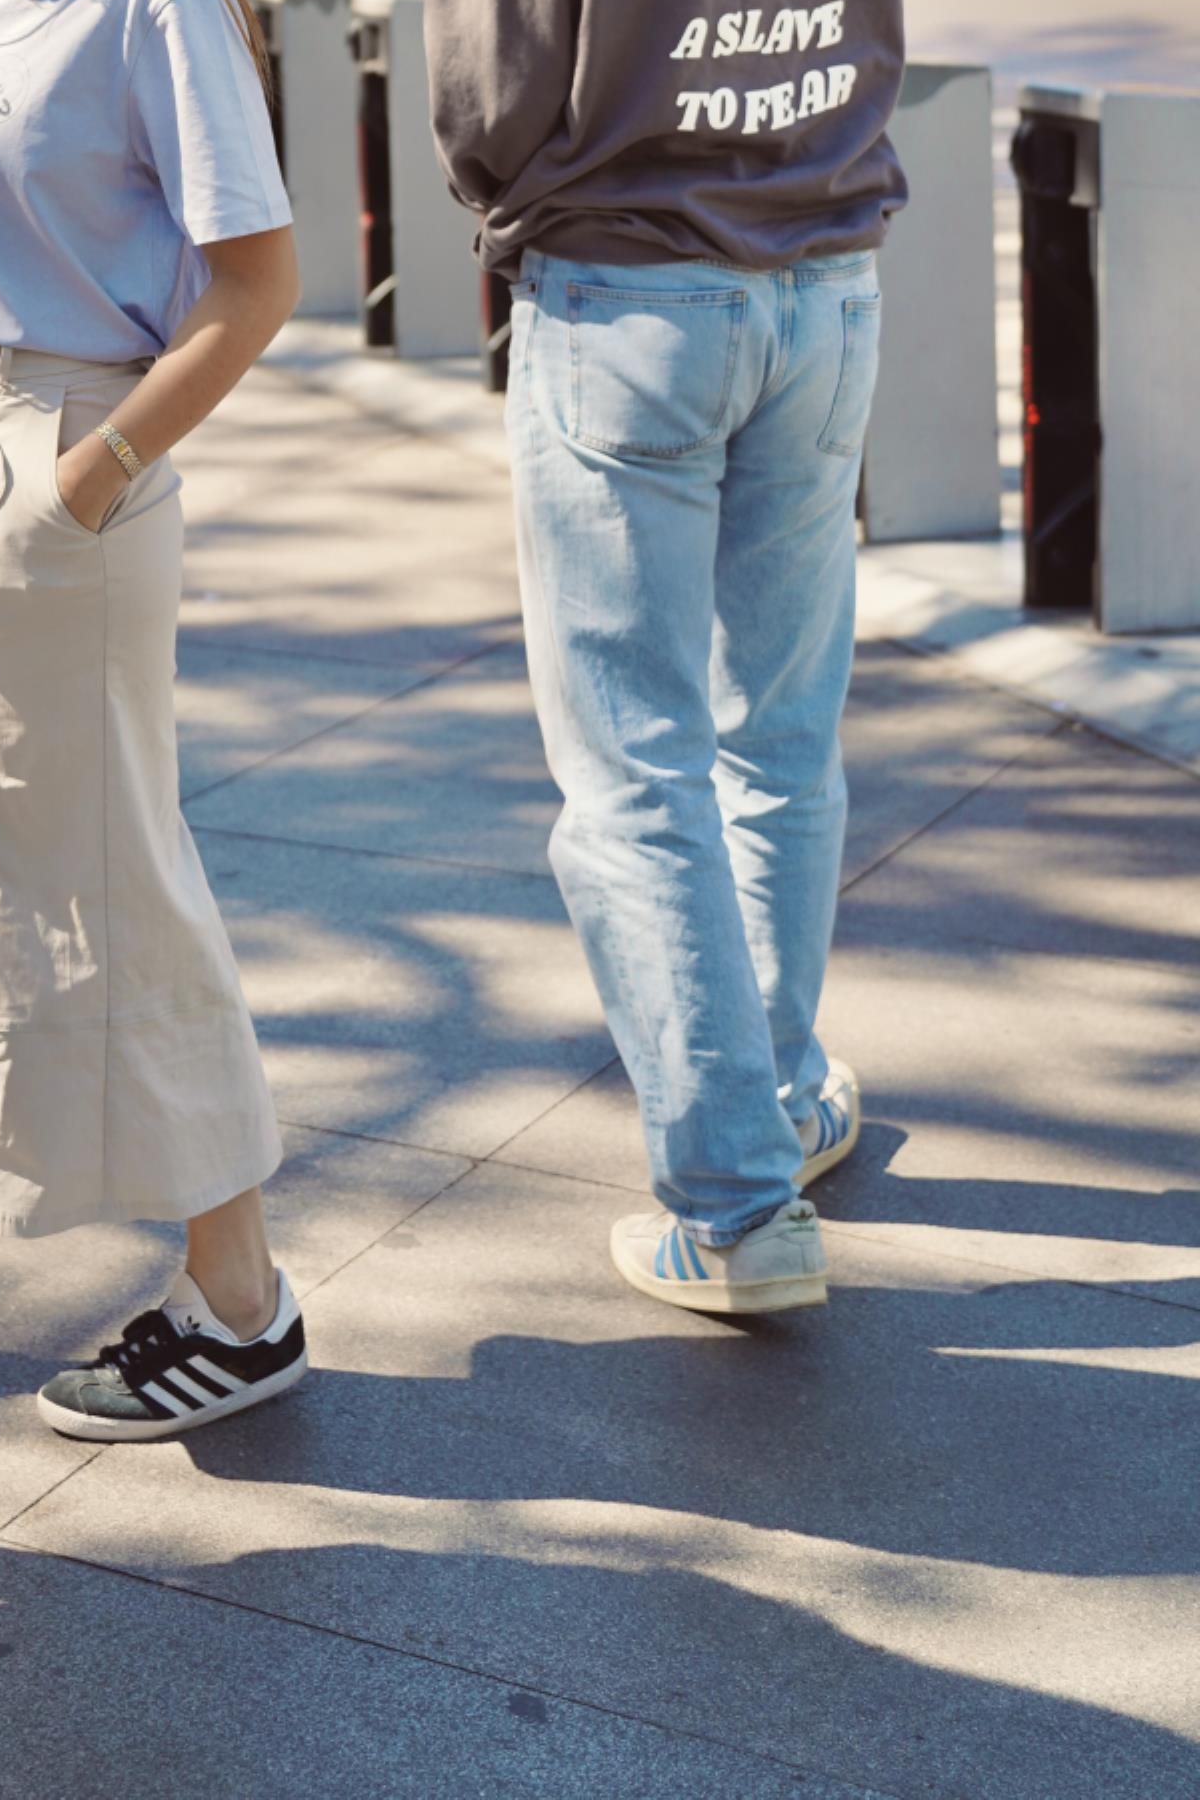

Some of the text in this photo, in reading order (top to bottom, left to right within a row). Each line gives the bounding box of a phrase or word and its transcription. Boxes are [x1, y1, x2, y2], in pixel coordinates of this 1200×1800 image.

[669, 0, 845, 59] A SLAVE
[675, 64, 857, 135] TO FEAR
